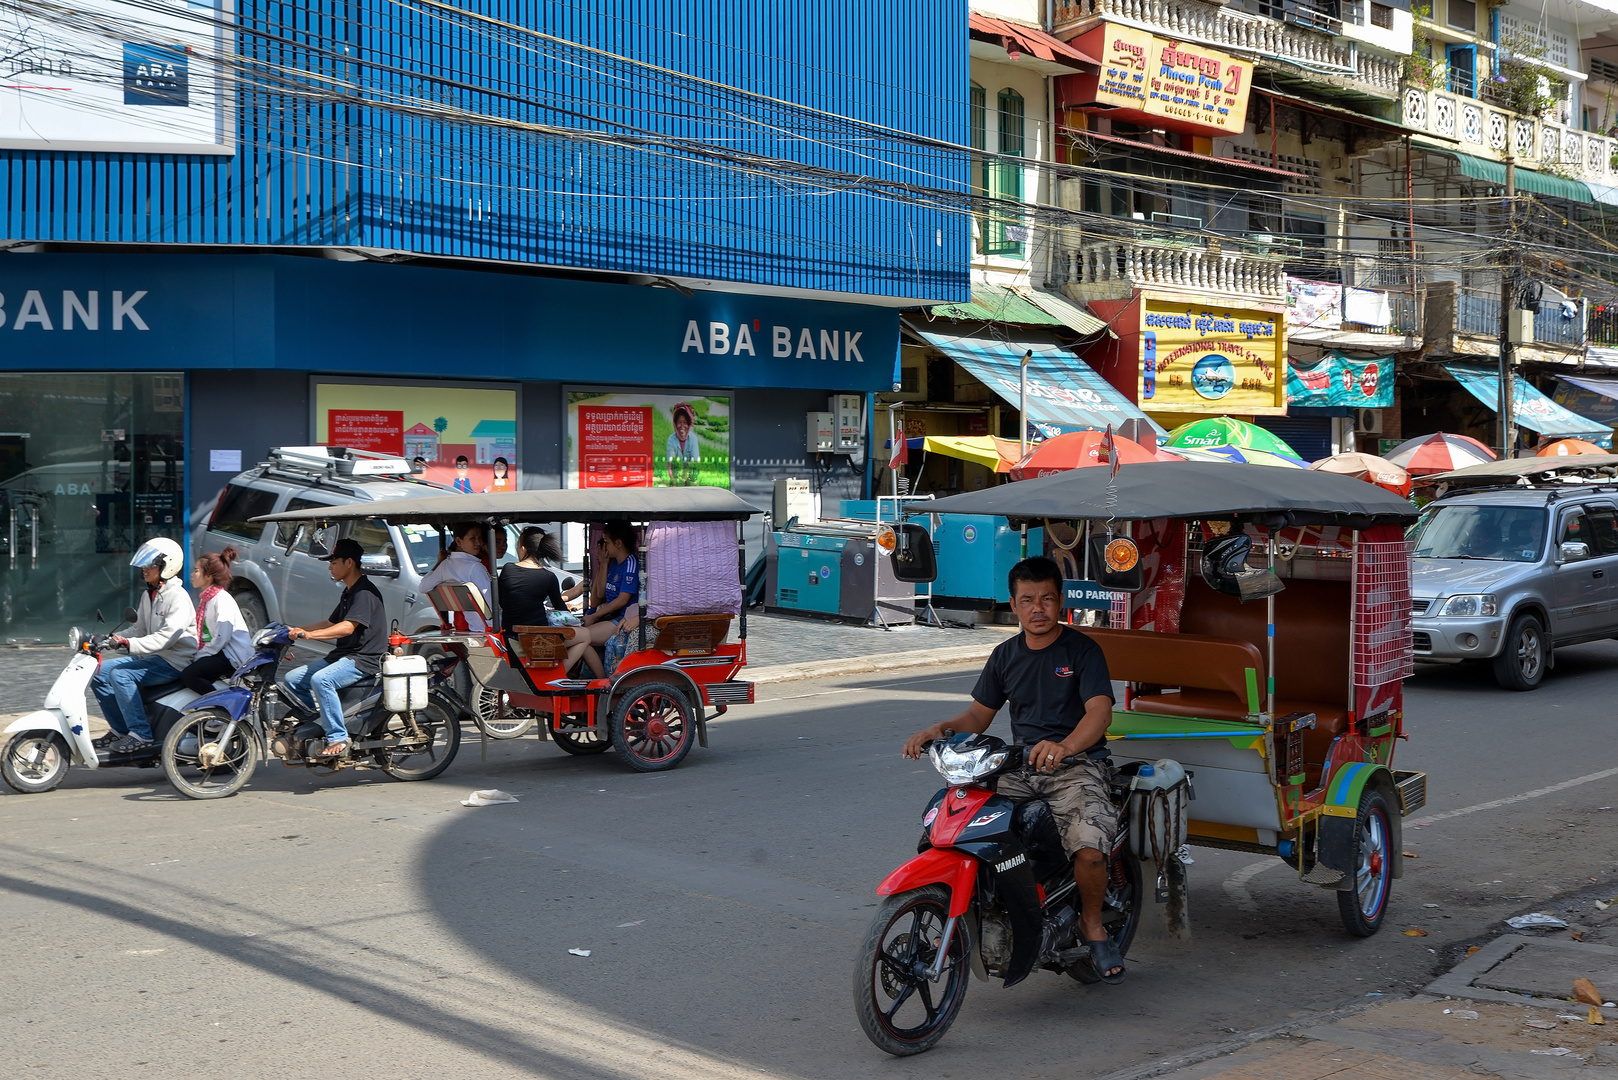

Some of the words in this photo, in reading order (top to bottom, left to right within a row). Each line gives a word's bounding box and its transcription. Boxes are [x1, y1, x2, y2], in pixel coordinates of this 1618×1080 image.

[136, 62, 176, 77] ABA
[1160, 65, 1195, 85] Phnom
[1198, 74, 1223, 92] Penh
[0, 290, 150, 330] ANK
[681, 319, 757, 356] ABA
[772, 325, 864, 362] BANK
[1157, 341, 1216, 374] INTERNATIONAL
[1217, 341, 1245, 358] TRAVEL
[1252, 354, 1273, 381] TOURS
[1183, 435, 1221, 449] Smart
[55, 483, 91, 495] ABA
[1067, 590, 1083, 599] NO
[1085, 591, 1124, 601] PARKIN
[995, 853, 1027, 874] YAMAHA
